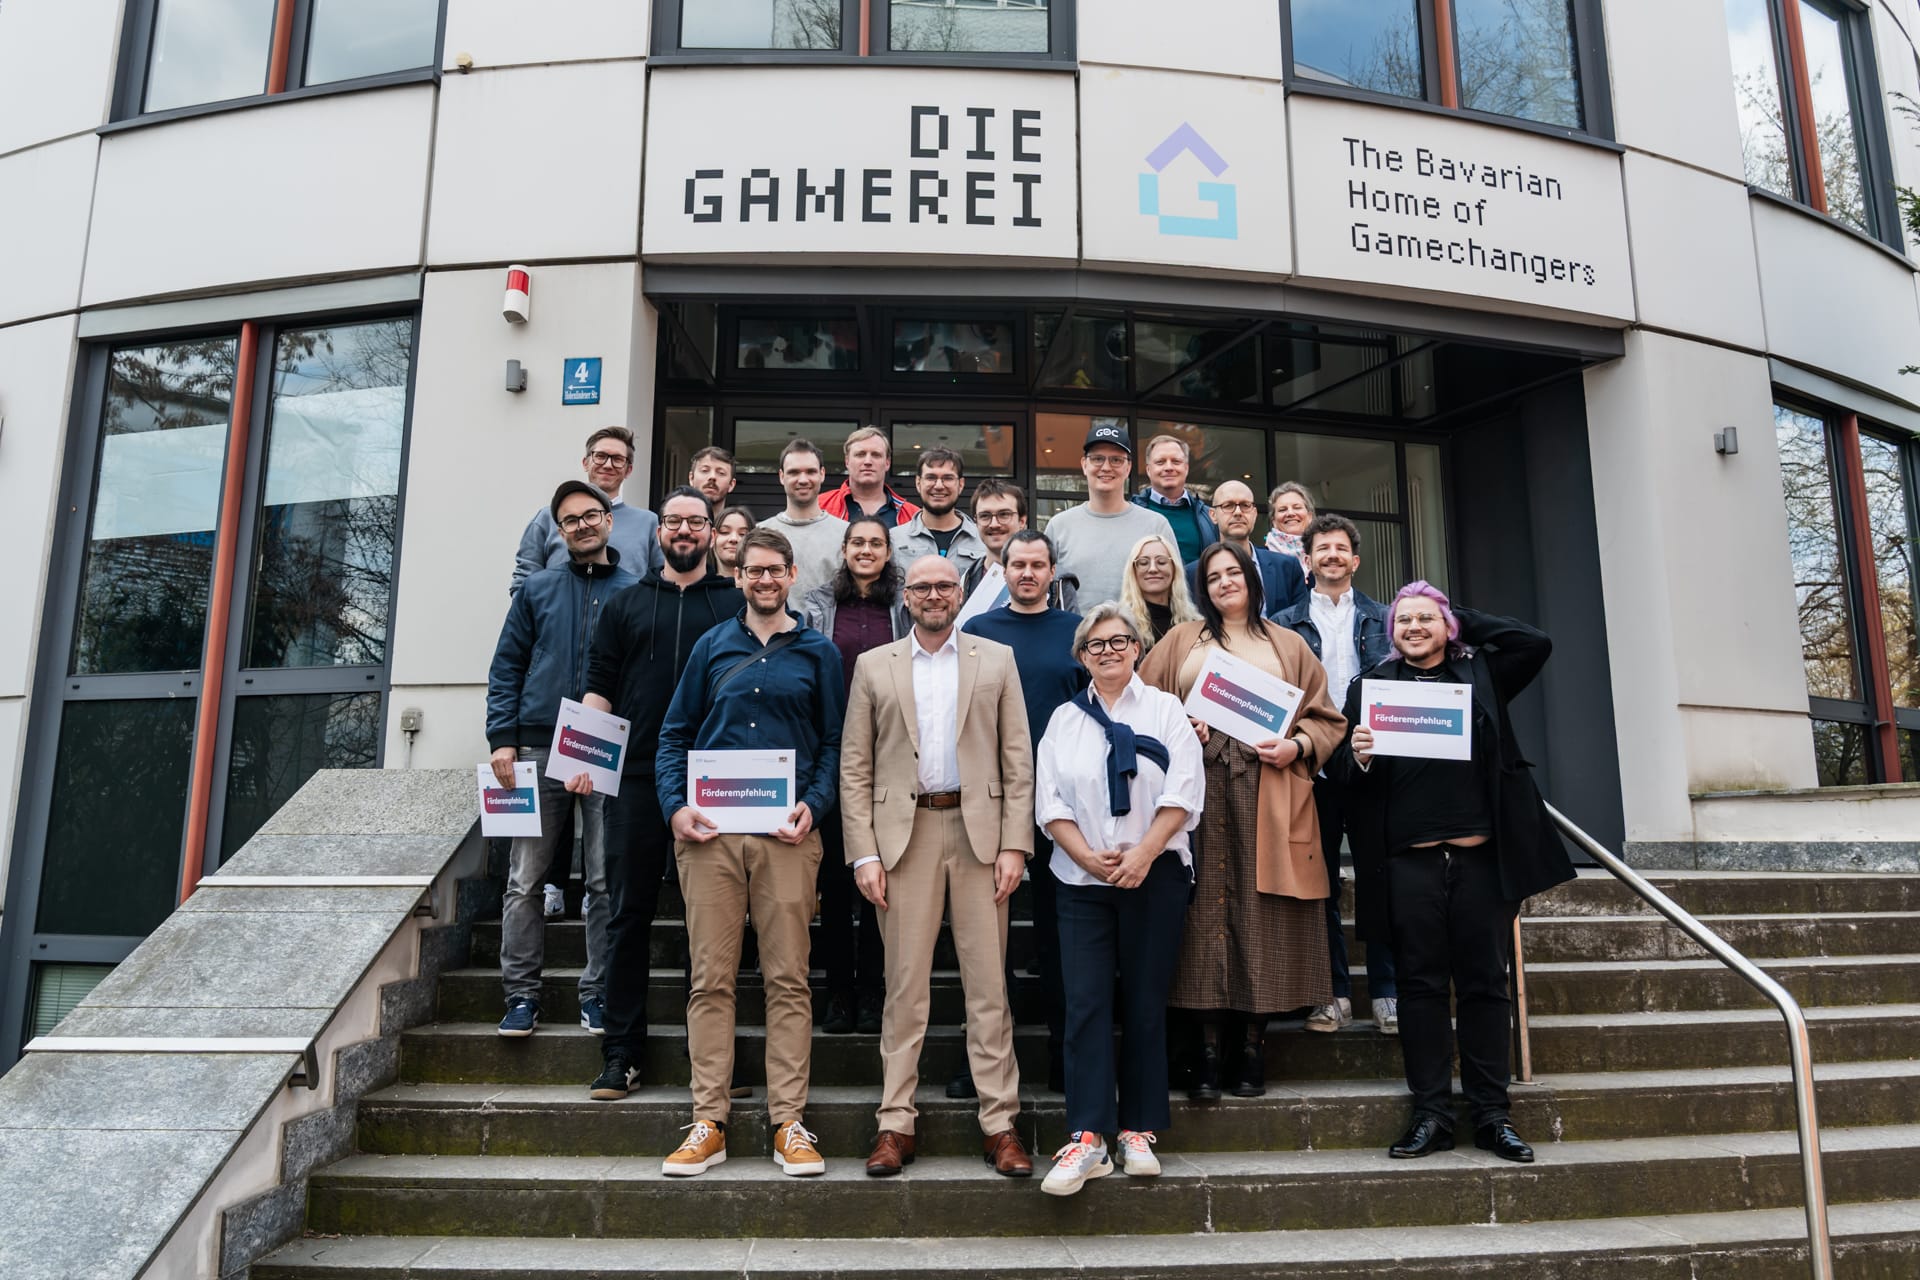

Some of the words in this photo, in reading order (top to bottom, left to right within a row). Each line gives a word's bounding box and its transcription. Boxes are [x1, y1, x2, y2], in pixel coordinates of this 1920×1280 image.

[910, 105, 1042, 163] DIE
[1342, 136, 1404, 173] The
[1415, 147, 1563, 201] Bavarian
[683, 167, 1042, 228] GAMEREI
[1347, 179, 1441, 220] Home
[1452, 198, 1488, 227] of
[1350, 221, 1596, 287] Gamechangers
[574, 361, 588, 383] 4
[1095, 427, 1119, 438] GDC
[1207, 681, 1276, 723] Förderempfehlung
[1374, 713, 1453, 728] Förderempfehlung
[562, 737, 614, 762] Förderempfehlung
[487, 796, 530, 807] Förderempfehlung
[701, 788, 778, 799] Förderempfehlung
